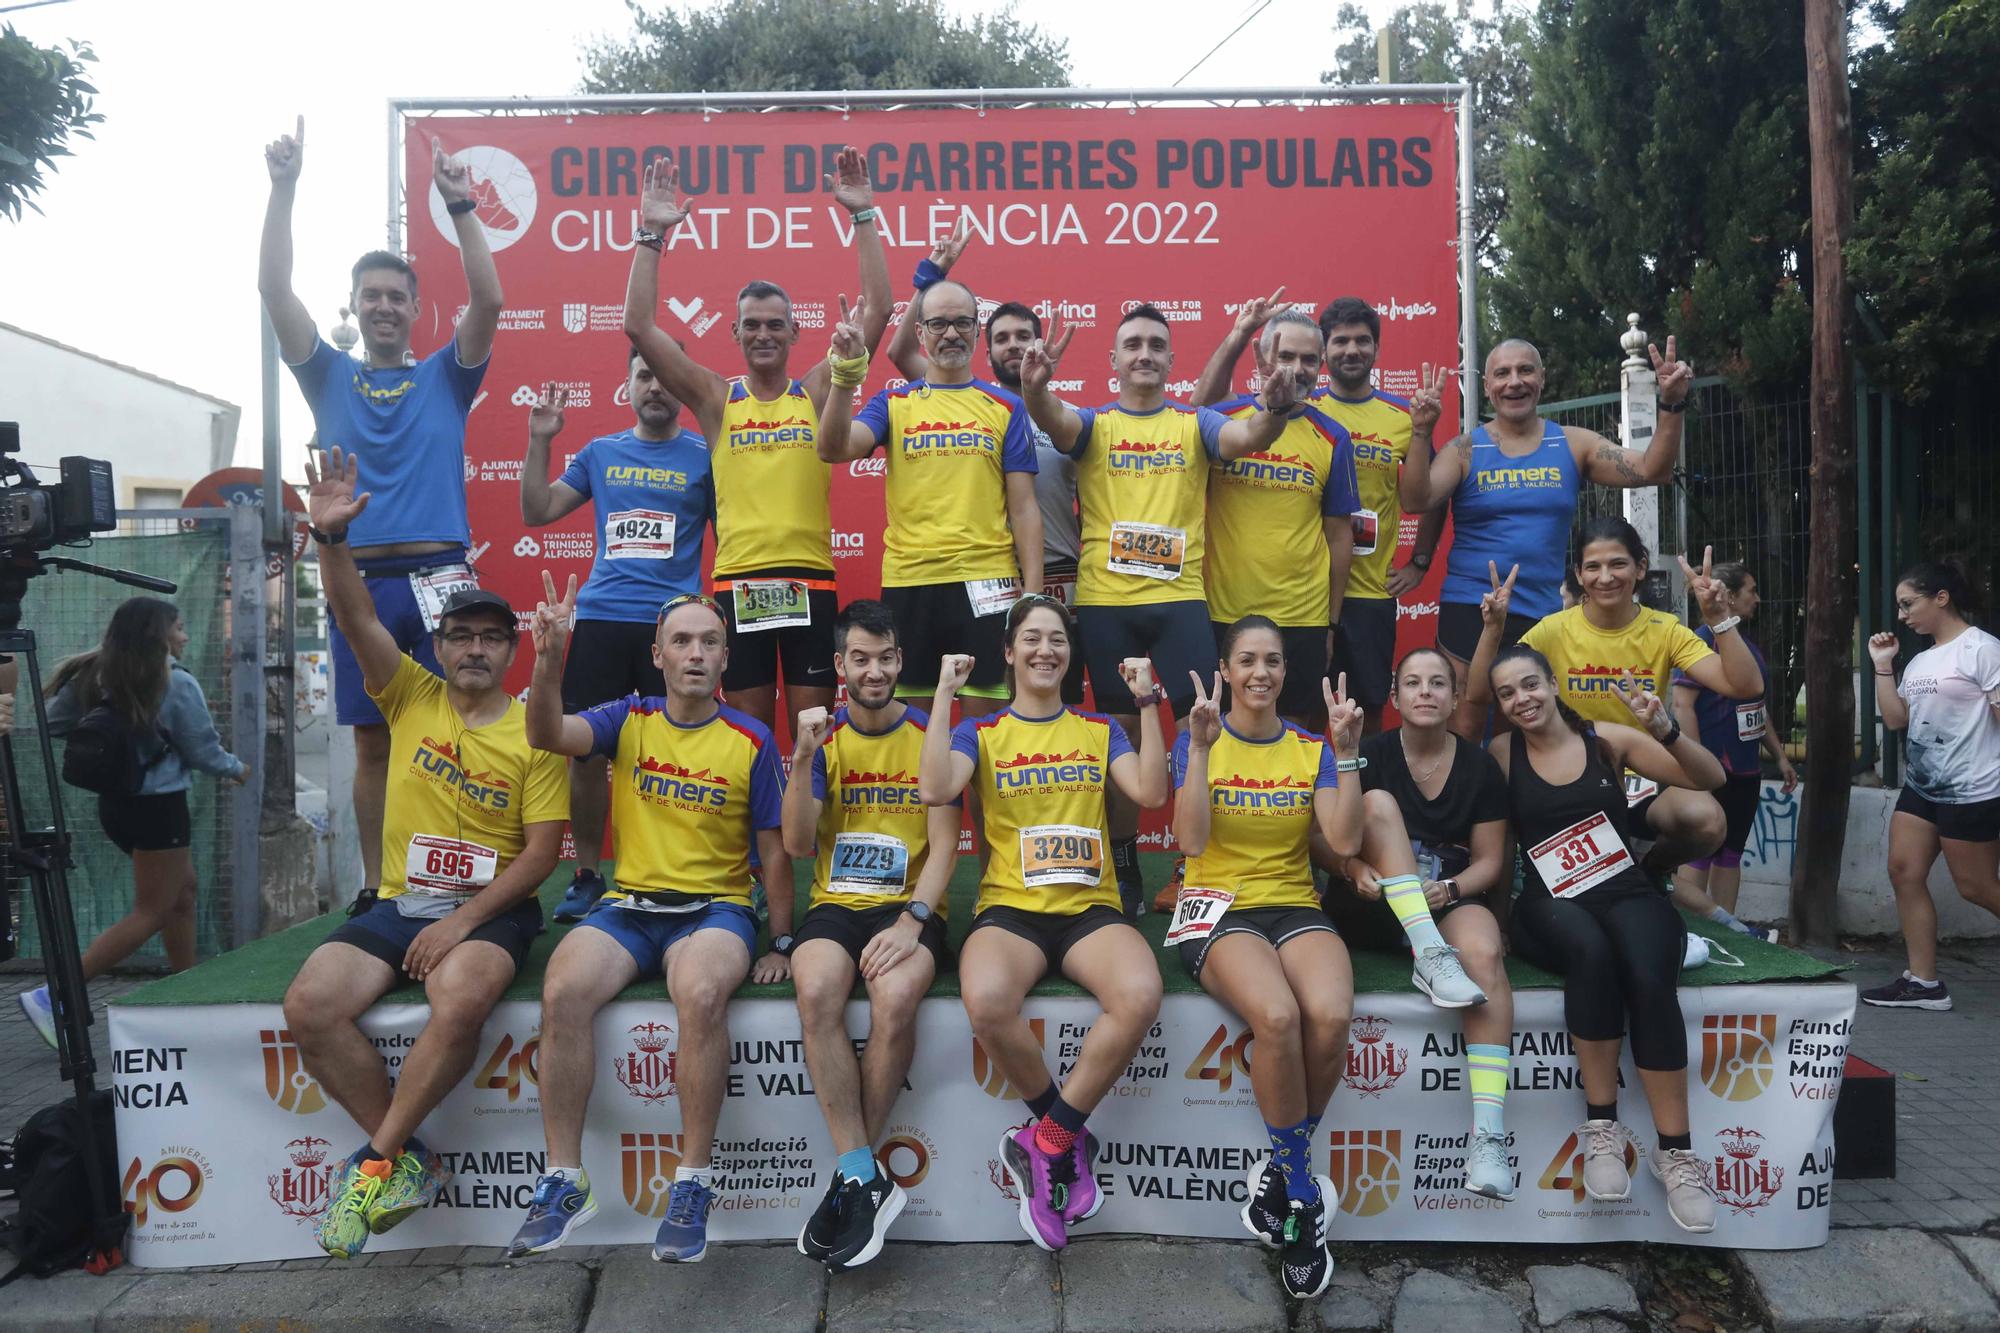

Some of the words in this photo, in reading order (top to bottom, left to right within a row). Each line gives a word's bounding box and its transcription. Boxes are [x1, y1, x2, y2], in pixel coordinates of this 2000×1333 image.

[867, 138, 1138, 193] CARRERES
[1157, 136, 1433, 189] POPULARS
[551, 207, 730, 252] CIUAT
[747, 206, 813, 249] DE
[1105, 201, 1219, 245] 2022
[1182, 300, 1201, 309] FOR
[1162, 310, 1201, 321] EEDOM
[729, 428, 814, 448] runners
[903, 431, 995, 452] runners
[731, 447, 757, 456] CIUTAT
[904, 450, 933, 461] CIUTAT
[936, 449, 950, 457] DE
[481, 471, 497, 481] DE
[498, 470, 523, 481] VALÈ
[605, 465, 687, 485] runners
[849, 456, 887, 477] Coca
[1222, 460, 1316, 486] runners
[1477, 466, 1562, 485] runners
[633, 480, 645, 488] DE
[1253, 479, 1266, 488] DE
[1478, 483, 1507, 493] CIUTAT
[615, 520, 663, 540] 4924
[831, 528, 864, 548] ina
[543, 540, 593, 550] TRINIDAD
[543, 549, 593, 559] ALFONSO
[1121, 531, 1173, 558] 3423
[1906, 678, 1938, 689] CARRERA
[409, 766, 440, 786] CIUTAT
[441, 784, 456, 797] DE
[412, 746, 510, 809] runners
[633, 766, 727, 807] runners
[996, 764, 1103, 790] runners
[656, 797, 670, 808] DE
[840, 785, 921, 806] unners
[998, 787, 1034, 800] CIUTAT
[1039, 786, 1054, 795] DE
[1213, 788, 1312, 808] runners
[1213, 807, 1248, 817] CIUTAT
[1251, 809, 1266, 817] DE
[840, 845, 895, 871] 2229
[1034, 836, 1093, 861] 3290
[1555, 833, 1601, 871] 331
[426, 849, 474, 880] 695
[1421, 1067, 1461, 1091] DE
[711, 1137, 807, 1153] Fundació
[889, 1125, 939, 1160] ANIVERSARI
[160, 1145, 214, 1180] ANIVERSARI
[710, 1155, 813, 1172] Esportiva
[121, 1156, 204, 1229] 40
[710, 1173, 816, 1192] Municipal
[1127, 1173, 1249, 1203] VALÈNC
[708, 1192, 801, 1211] València
[1413, 1194, 1506, 1211] València
[1796, 1186, 1829, 1210] DE
[1537, 1208, 1572, 1219] Quaranta
